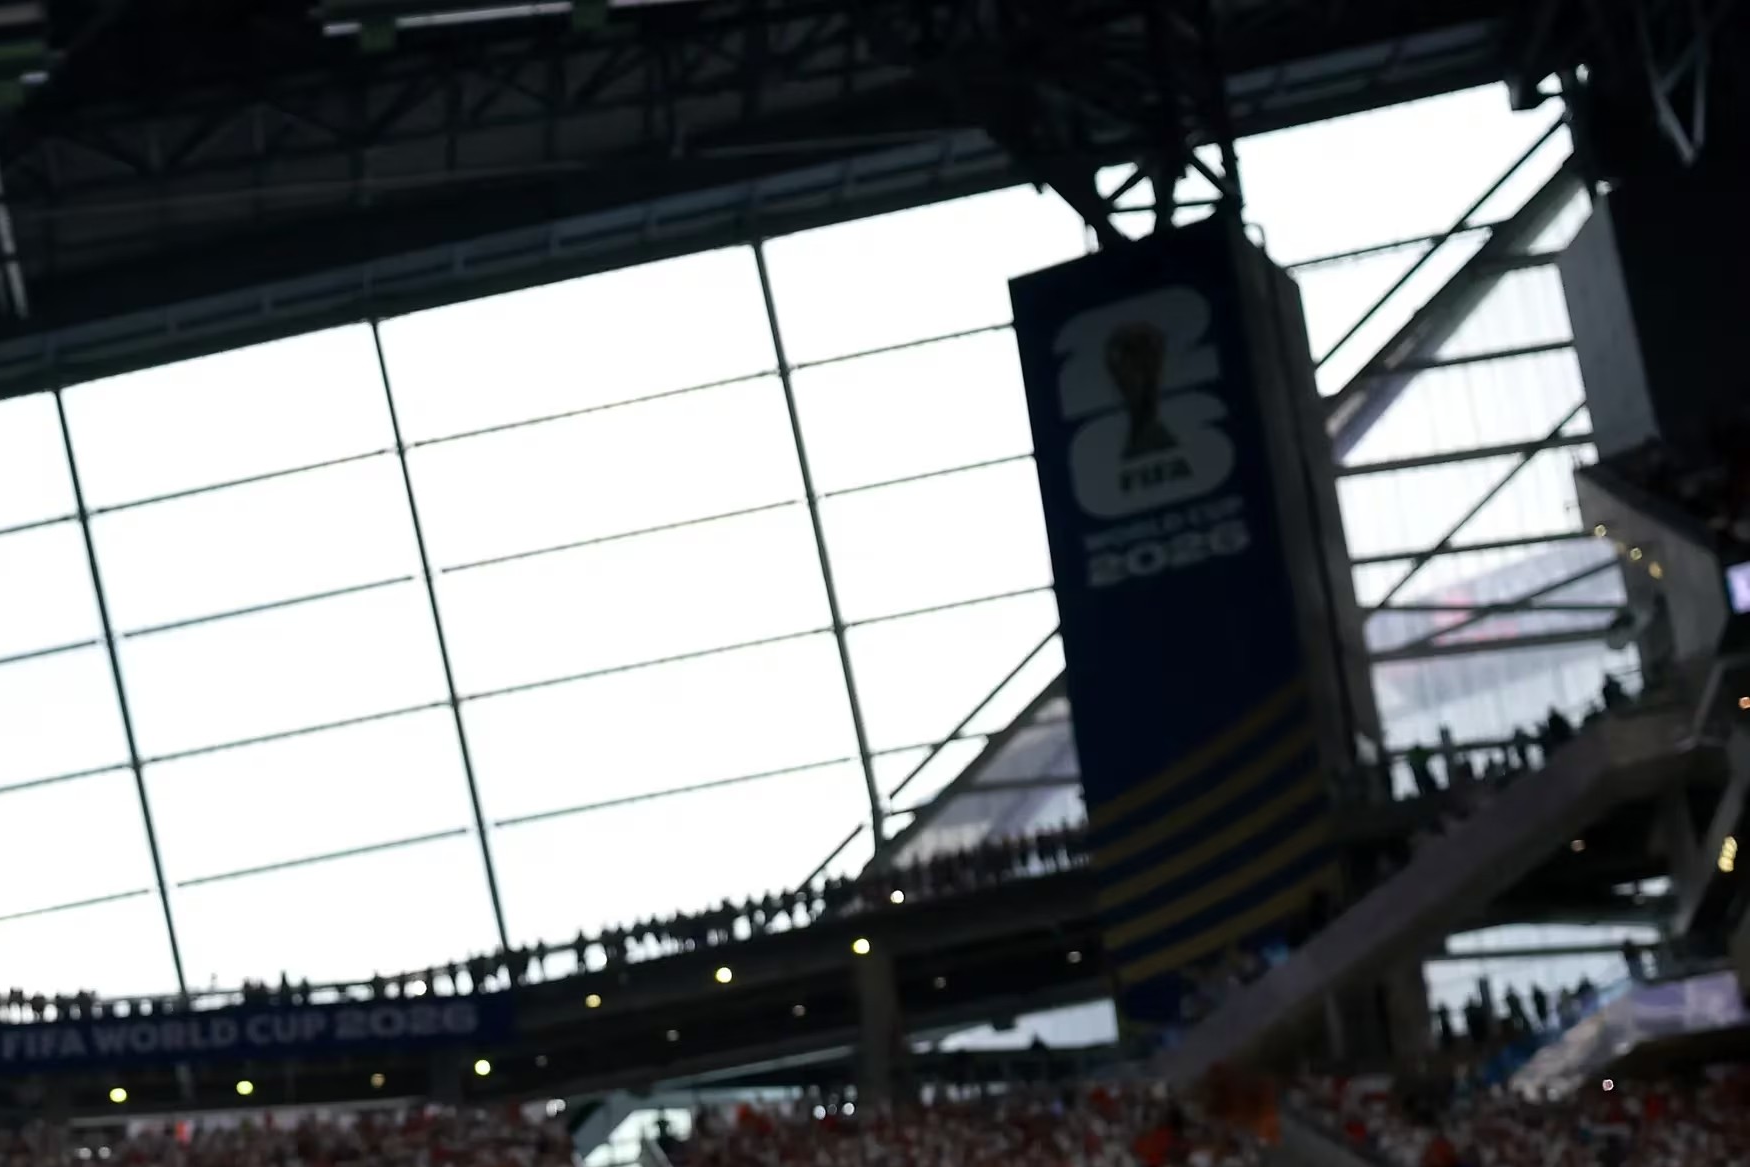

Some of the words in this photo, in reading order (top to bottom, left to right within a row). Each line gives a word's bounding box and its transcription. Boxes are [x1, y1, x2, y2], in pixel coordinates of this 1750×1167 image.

[0, 1029, 87, 1061] FIFA
[91, 1018, 240, 1055] WORLD
[245, 1012, 329, 1047] CUP
[334, 1001, 480, 1041] 2026
